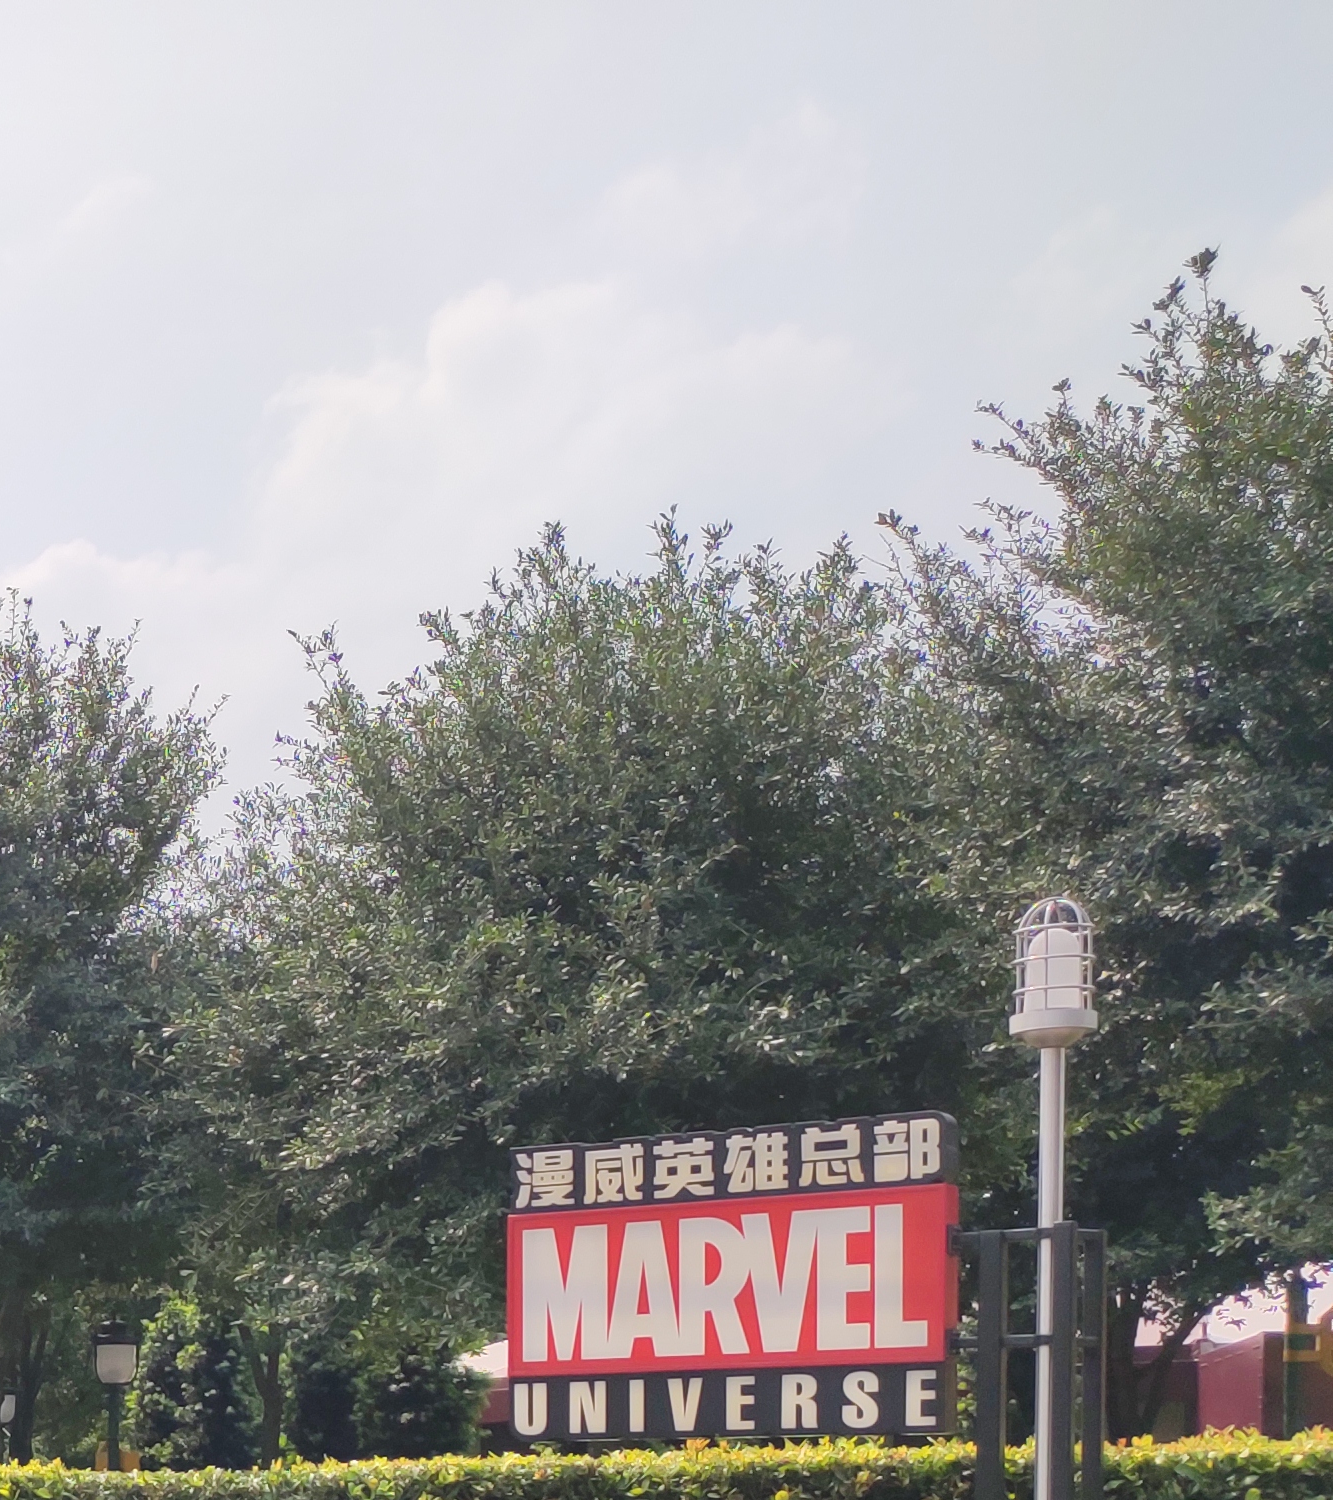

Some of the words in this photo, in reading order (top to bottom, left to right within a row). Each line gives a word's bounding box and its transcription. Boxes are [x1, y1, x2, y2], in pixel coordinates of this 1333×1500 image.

[516, 1118, 941, 1209] 漫威英雄总部
[522, 1204, 928, 1362] MARVEL
[514, 1369, 937, 1436] UNIVERSE
